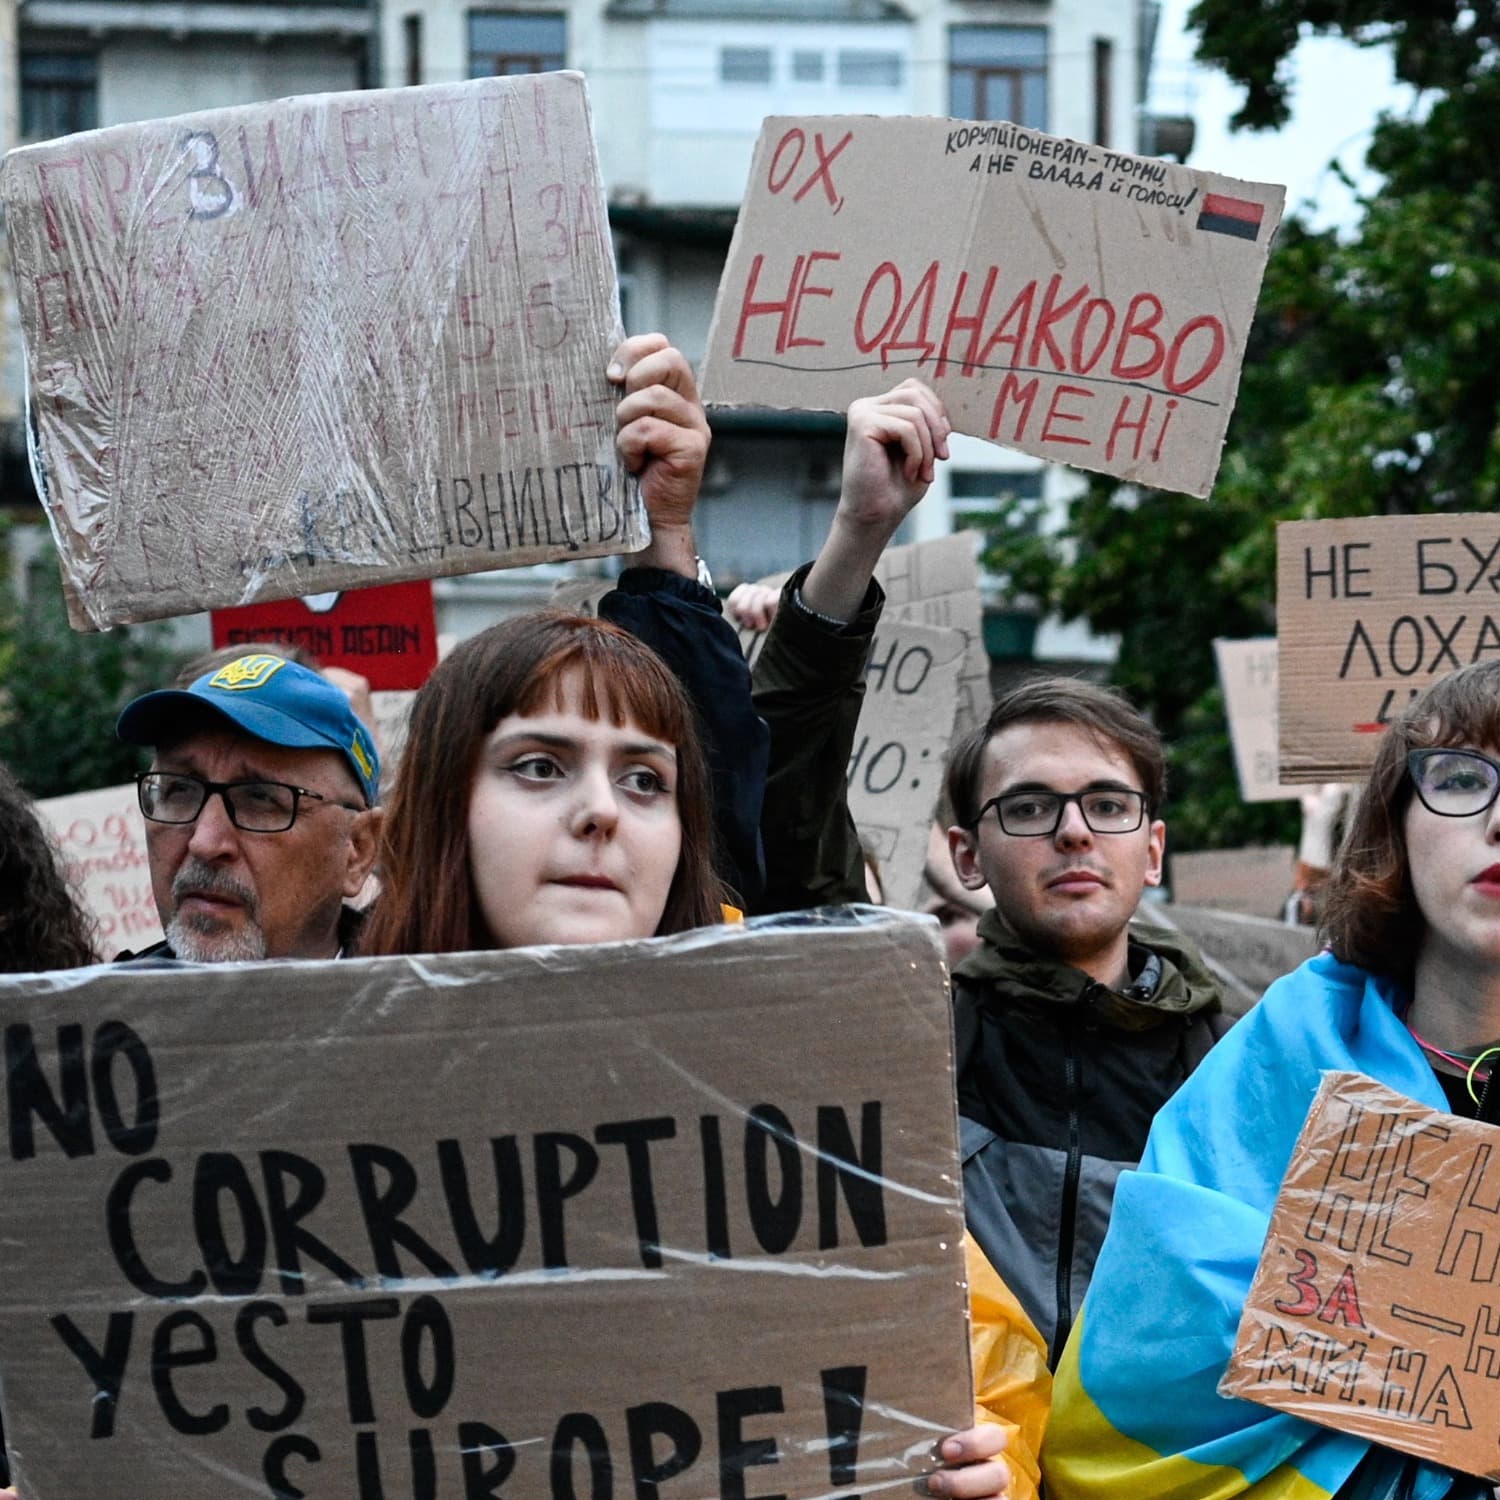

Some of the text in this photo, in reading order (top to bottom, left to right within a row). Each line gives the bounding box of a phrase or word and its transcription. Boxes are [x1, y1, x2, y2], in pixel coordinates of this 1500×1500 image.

[987, 154, 1018, 175] НЕ
[1028, 161, 1104, 190] ВЛАДА
[731, 251, 1225, 395] НЕ ОДНАКОВО
[989, 371, 1179, 463] МЕНІ
[1305, 543, 1372, 599] НЕ
[6, 1020, 160, 1162] NO
[105, 1100, 888, 1300] CORRUPTION
[1304, 1100, 1451, 1268] НЕ
[307, 1294, 455, 1425] TO
[1377, 1346, 1472, 1430] НА
